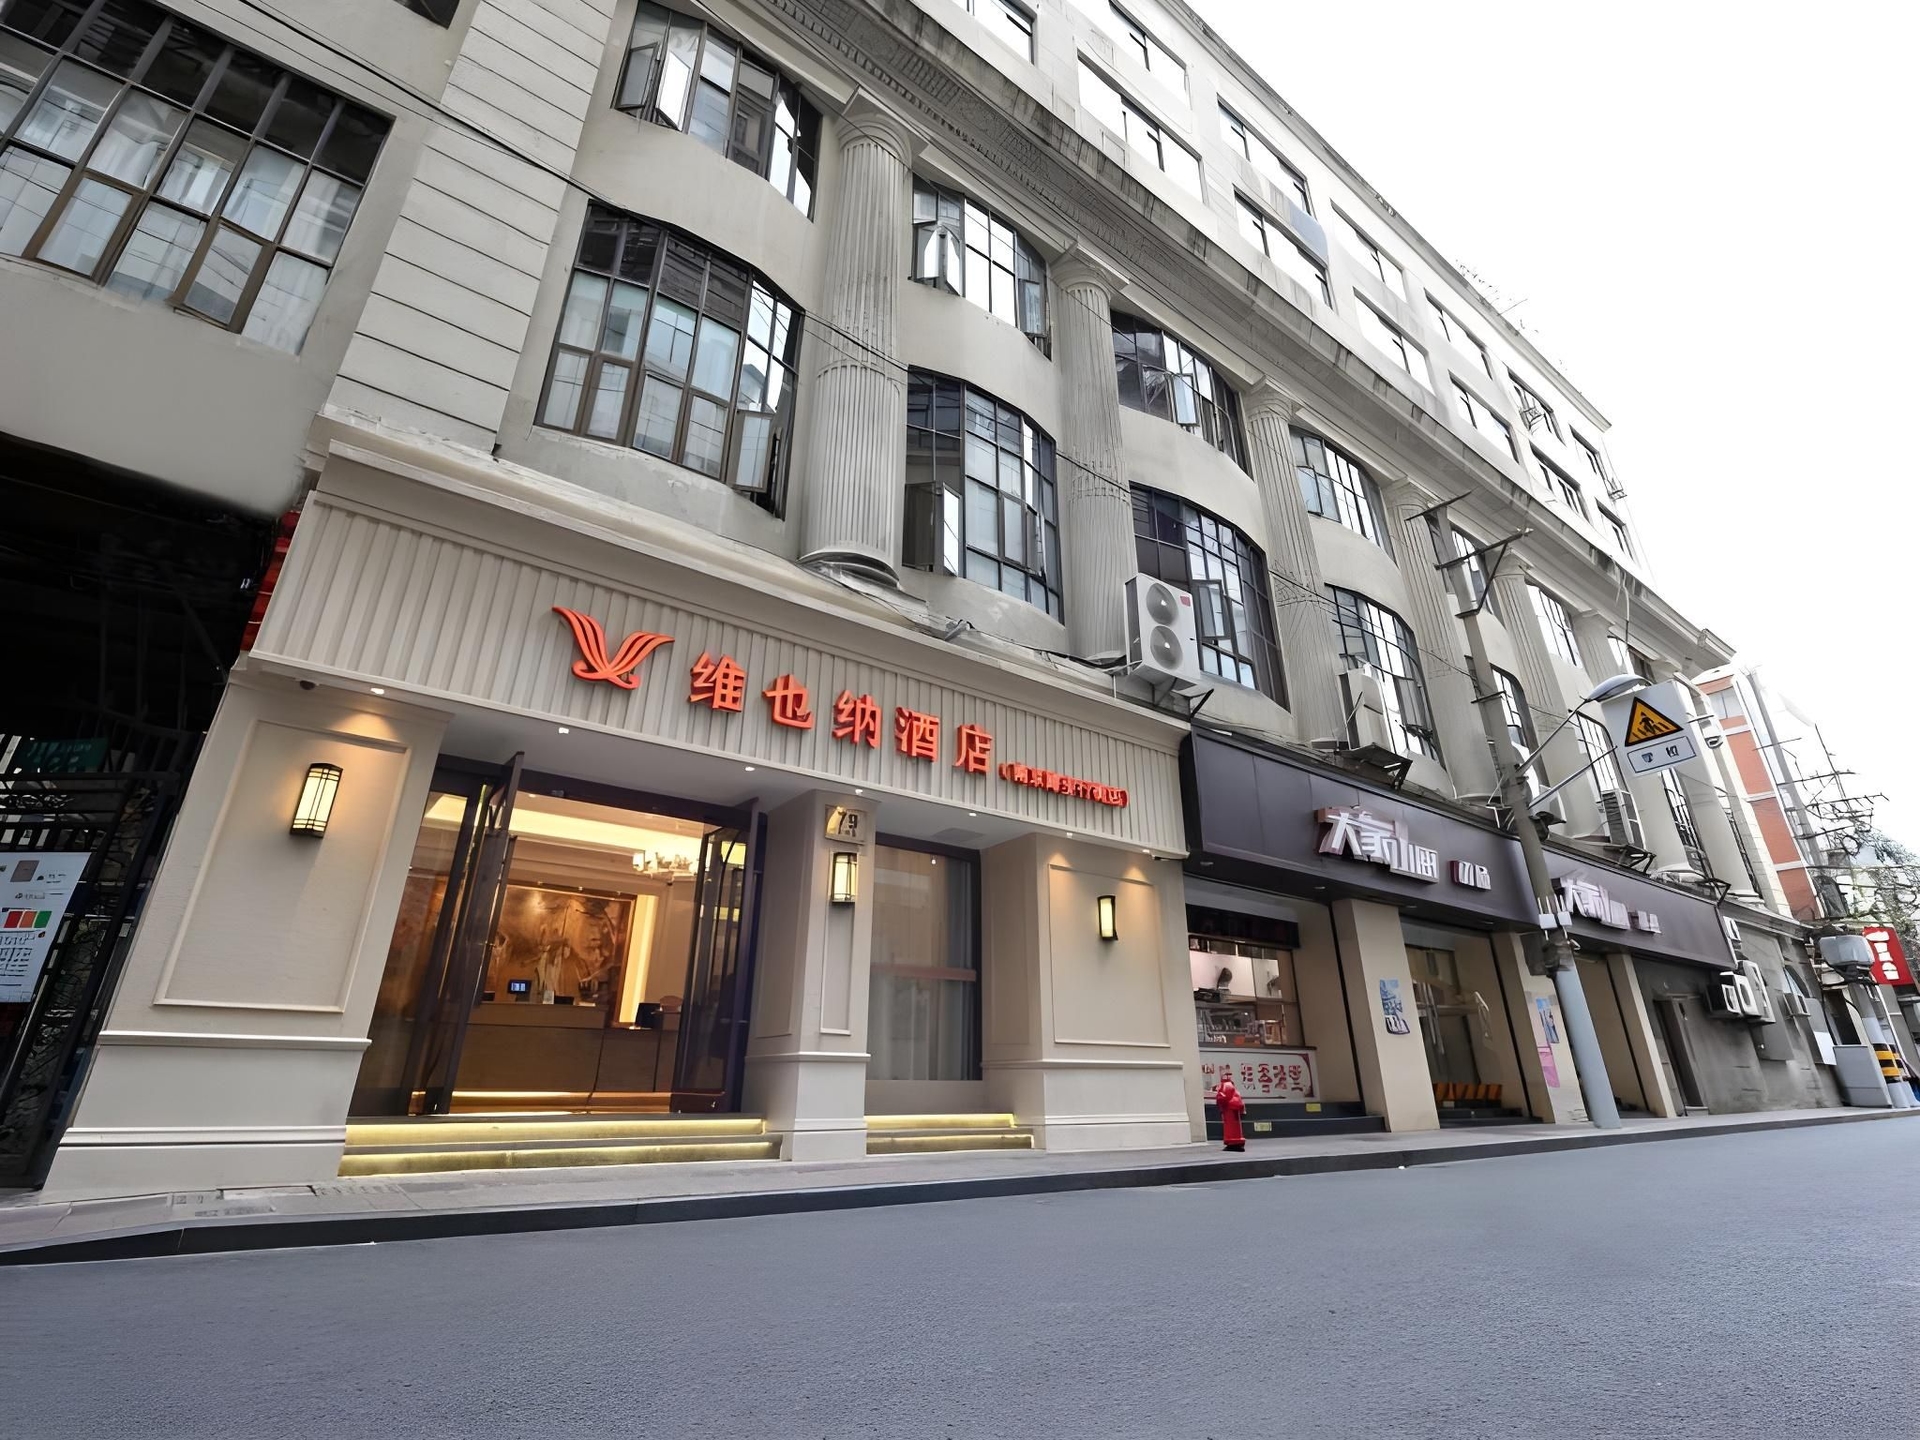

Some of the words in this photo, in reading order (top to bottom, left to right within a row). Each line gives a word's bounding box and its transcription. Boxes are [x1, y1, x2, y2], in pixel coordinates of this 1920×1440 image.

[688, 651, 993, 774] 维也纳酒店
